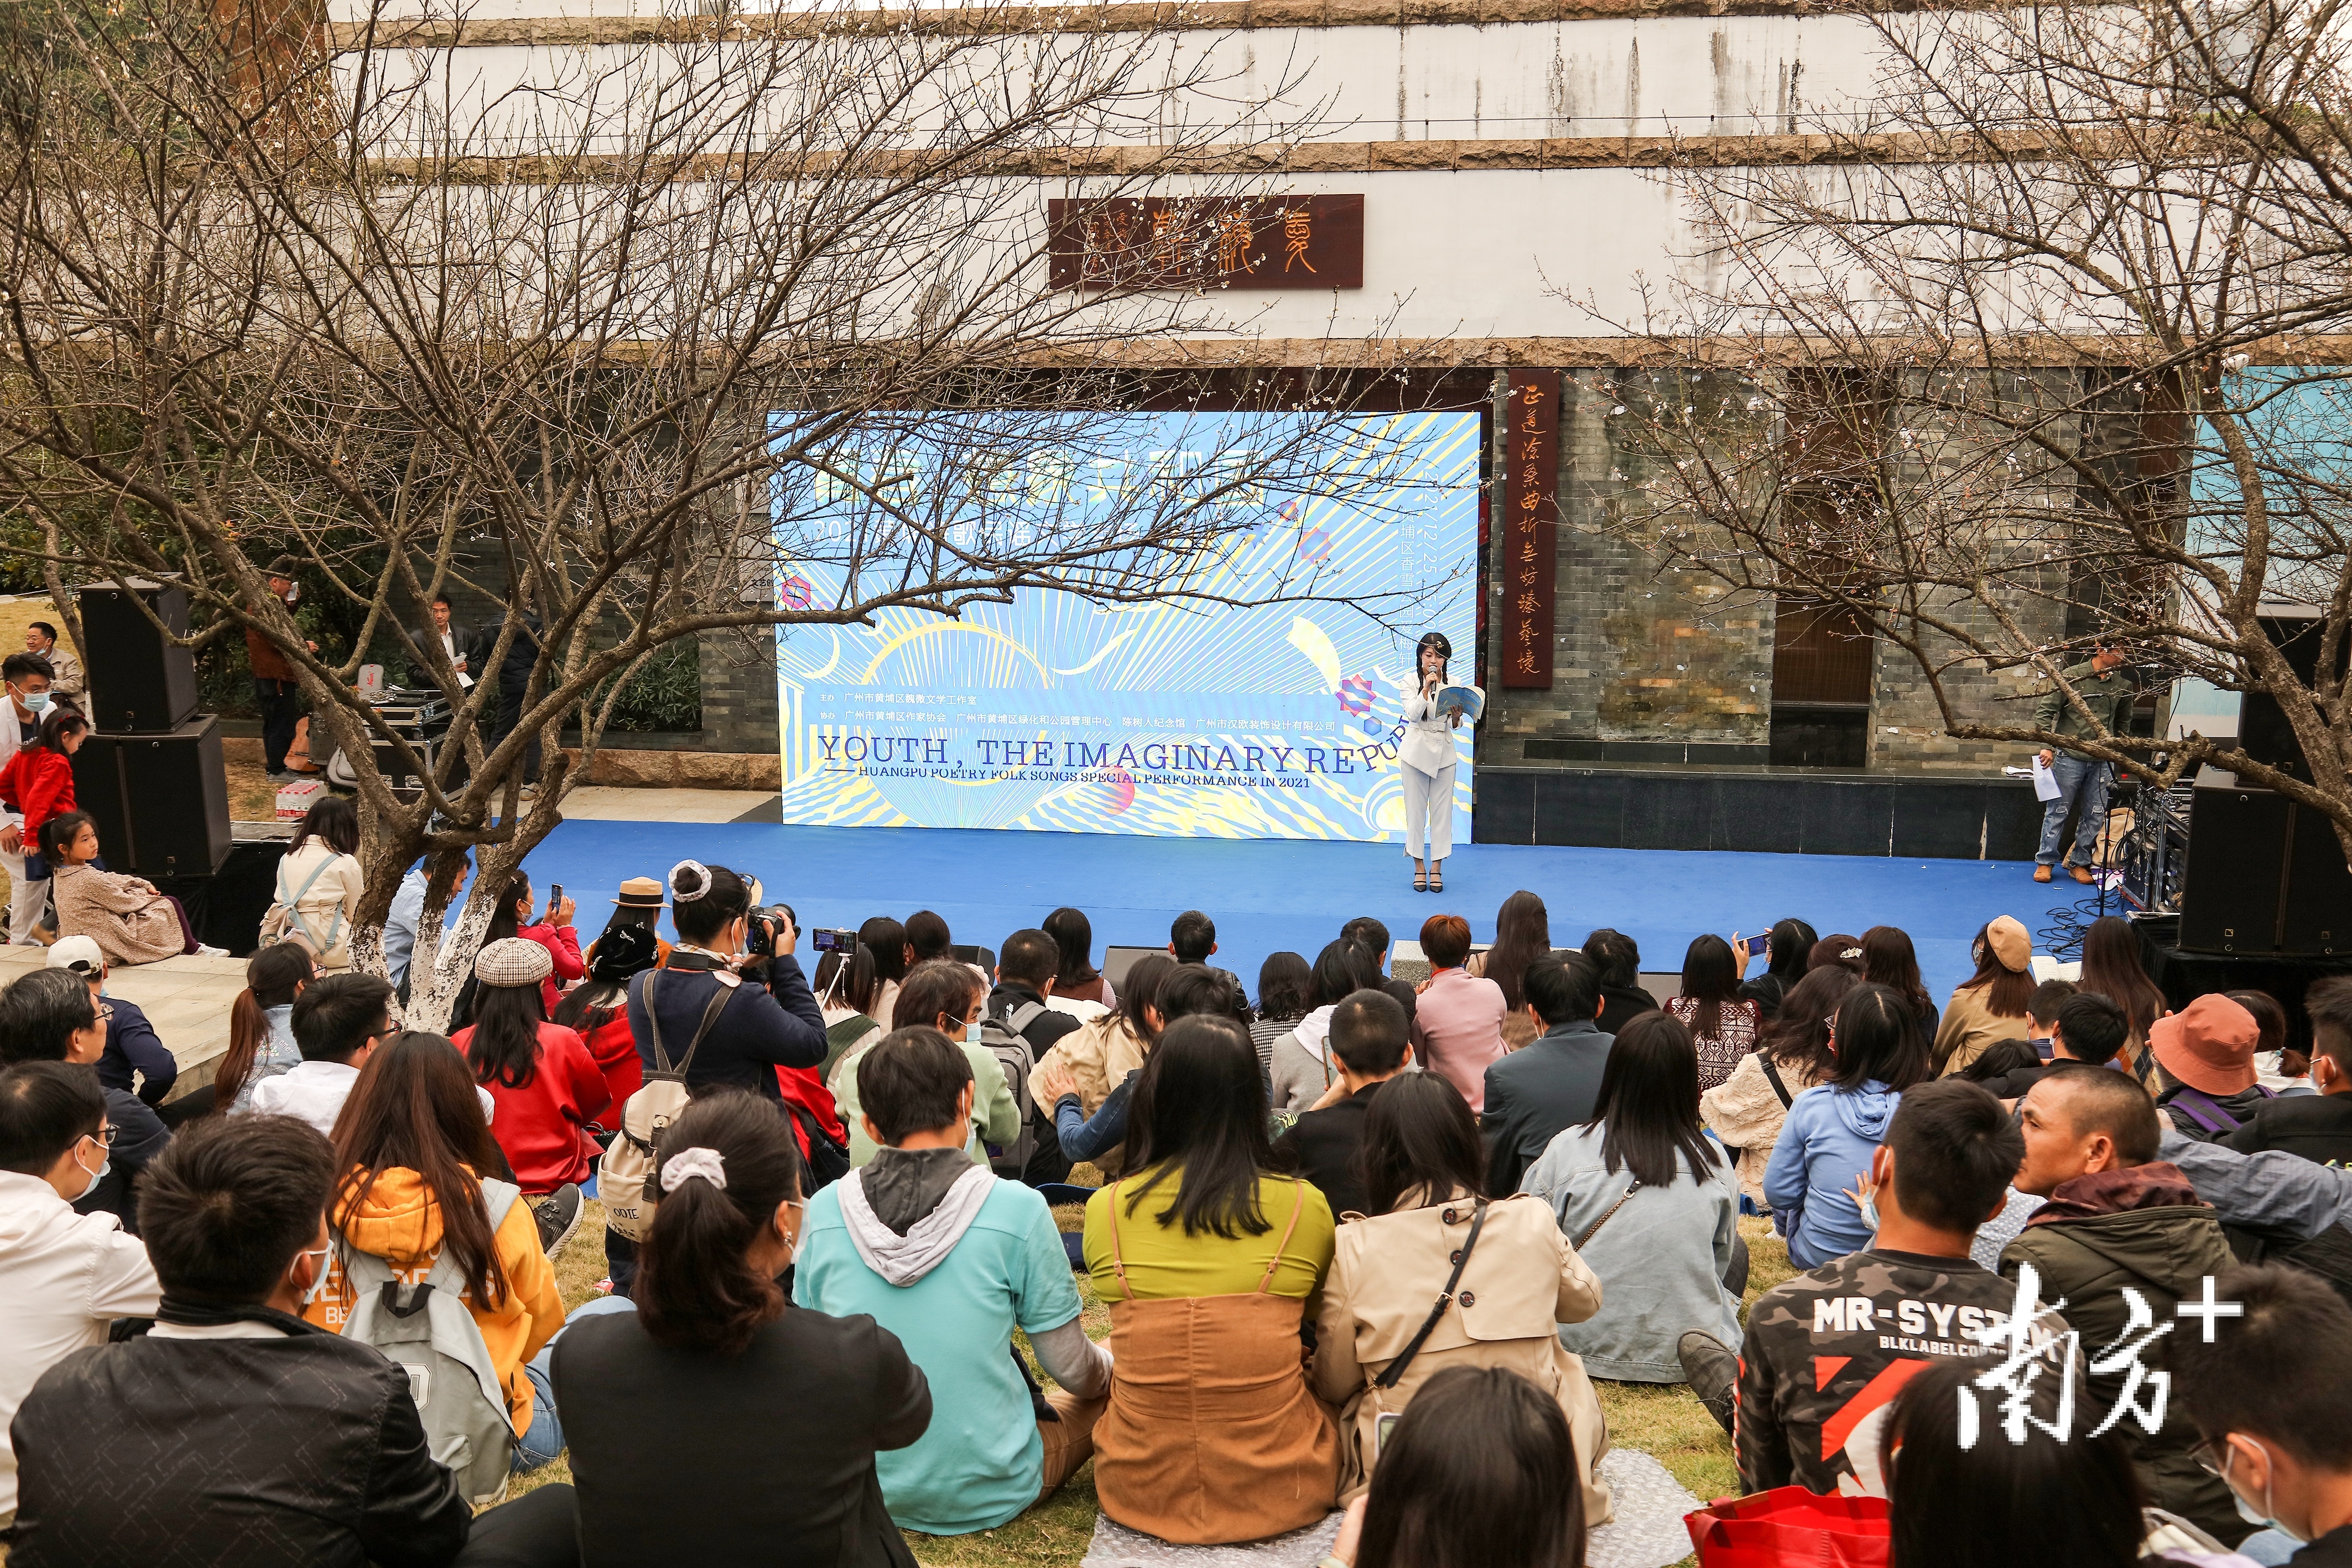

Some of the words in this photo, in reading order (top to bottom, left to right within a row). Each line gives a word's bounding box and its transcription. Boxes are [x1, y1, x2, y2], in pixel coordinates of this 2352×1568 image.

[1398, 508, 1416, 666] 黄埔区香雪公园爱梅轩
[820, 694, 835, 702] 主办
[844, 692, 977, 706] 广州市黄埔区魏微文学工作室
[820, 711, 835, 720] 协办
[844, 710, 946, 723] 广州市黄埔区作家协会
[956, 713, 1112, 726] 广州市黄埔区绿化和公园管理中心
[1122, 716, 1185, 728] 陈树人纪念馆
[1195, 718, 1335, 732] 广州市汉欧装饰设计有限公司
[818, 736, 962, 769] YOUTH,
[977, 739, 1053, 767] THE
[1064, 742, 1294, 773] IMAGINARY
[859, 766, 927, 778] HUANGPU
[932, 768, 986, 780] POETRY
[991, 770, 1027, 780] FOLK
[1030, 771, 1077, 782] SONGS
[1081, 772, 1141, 784] SPECIAL
[1144, 774, 1256, 787] PERFORMANCE
[1261, 777, 1275, 788] IN
[1279, 777, 1310, 788] 2021
[613, 1208, 639, 1220] ODIE
